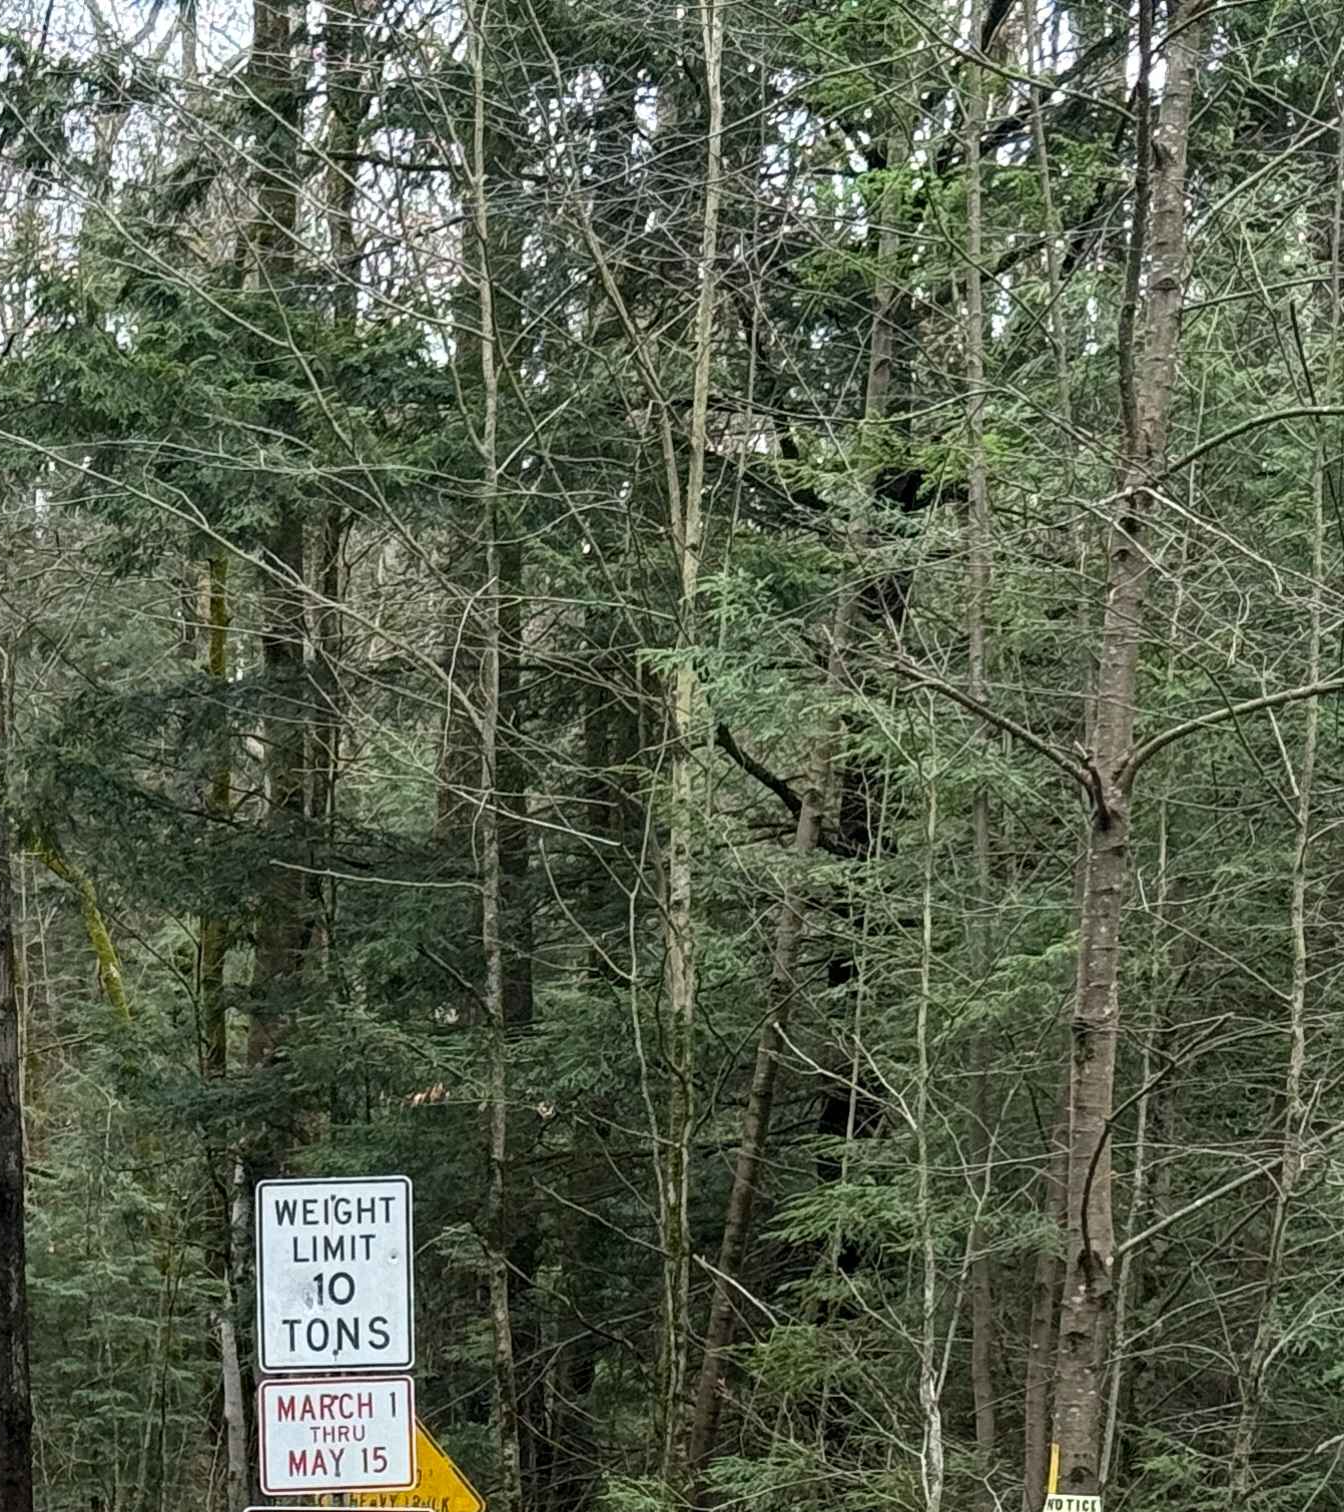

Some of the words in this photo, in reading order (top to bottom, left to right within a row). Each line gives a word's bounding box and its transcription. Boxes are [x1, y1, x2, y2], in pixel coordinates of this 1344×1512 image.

[275, 1197, 396, 1226] WEIGHT
[293, 1235, 376, 1263] LIMIT
[313, 1272, 355, 1305] 10
[282, 1316, 390, 1352] TONS
[277, 1392, 373, 1422] MARCH
[389, 1392, 398, 1417] 1
[310, 1426, 365, 1443] THRU
[288, 1447, 345, 1477] MAY
[362, 1447, 388, 1473] 15
[1047, 1498, 1097, 1512] NOTICE
